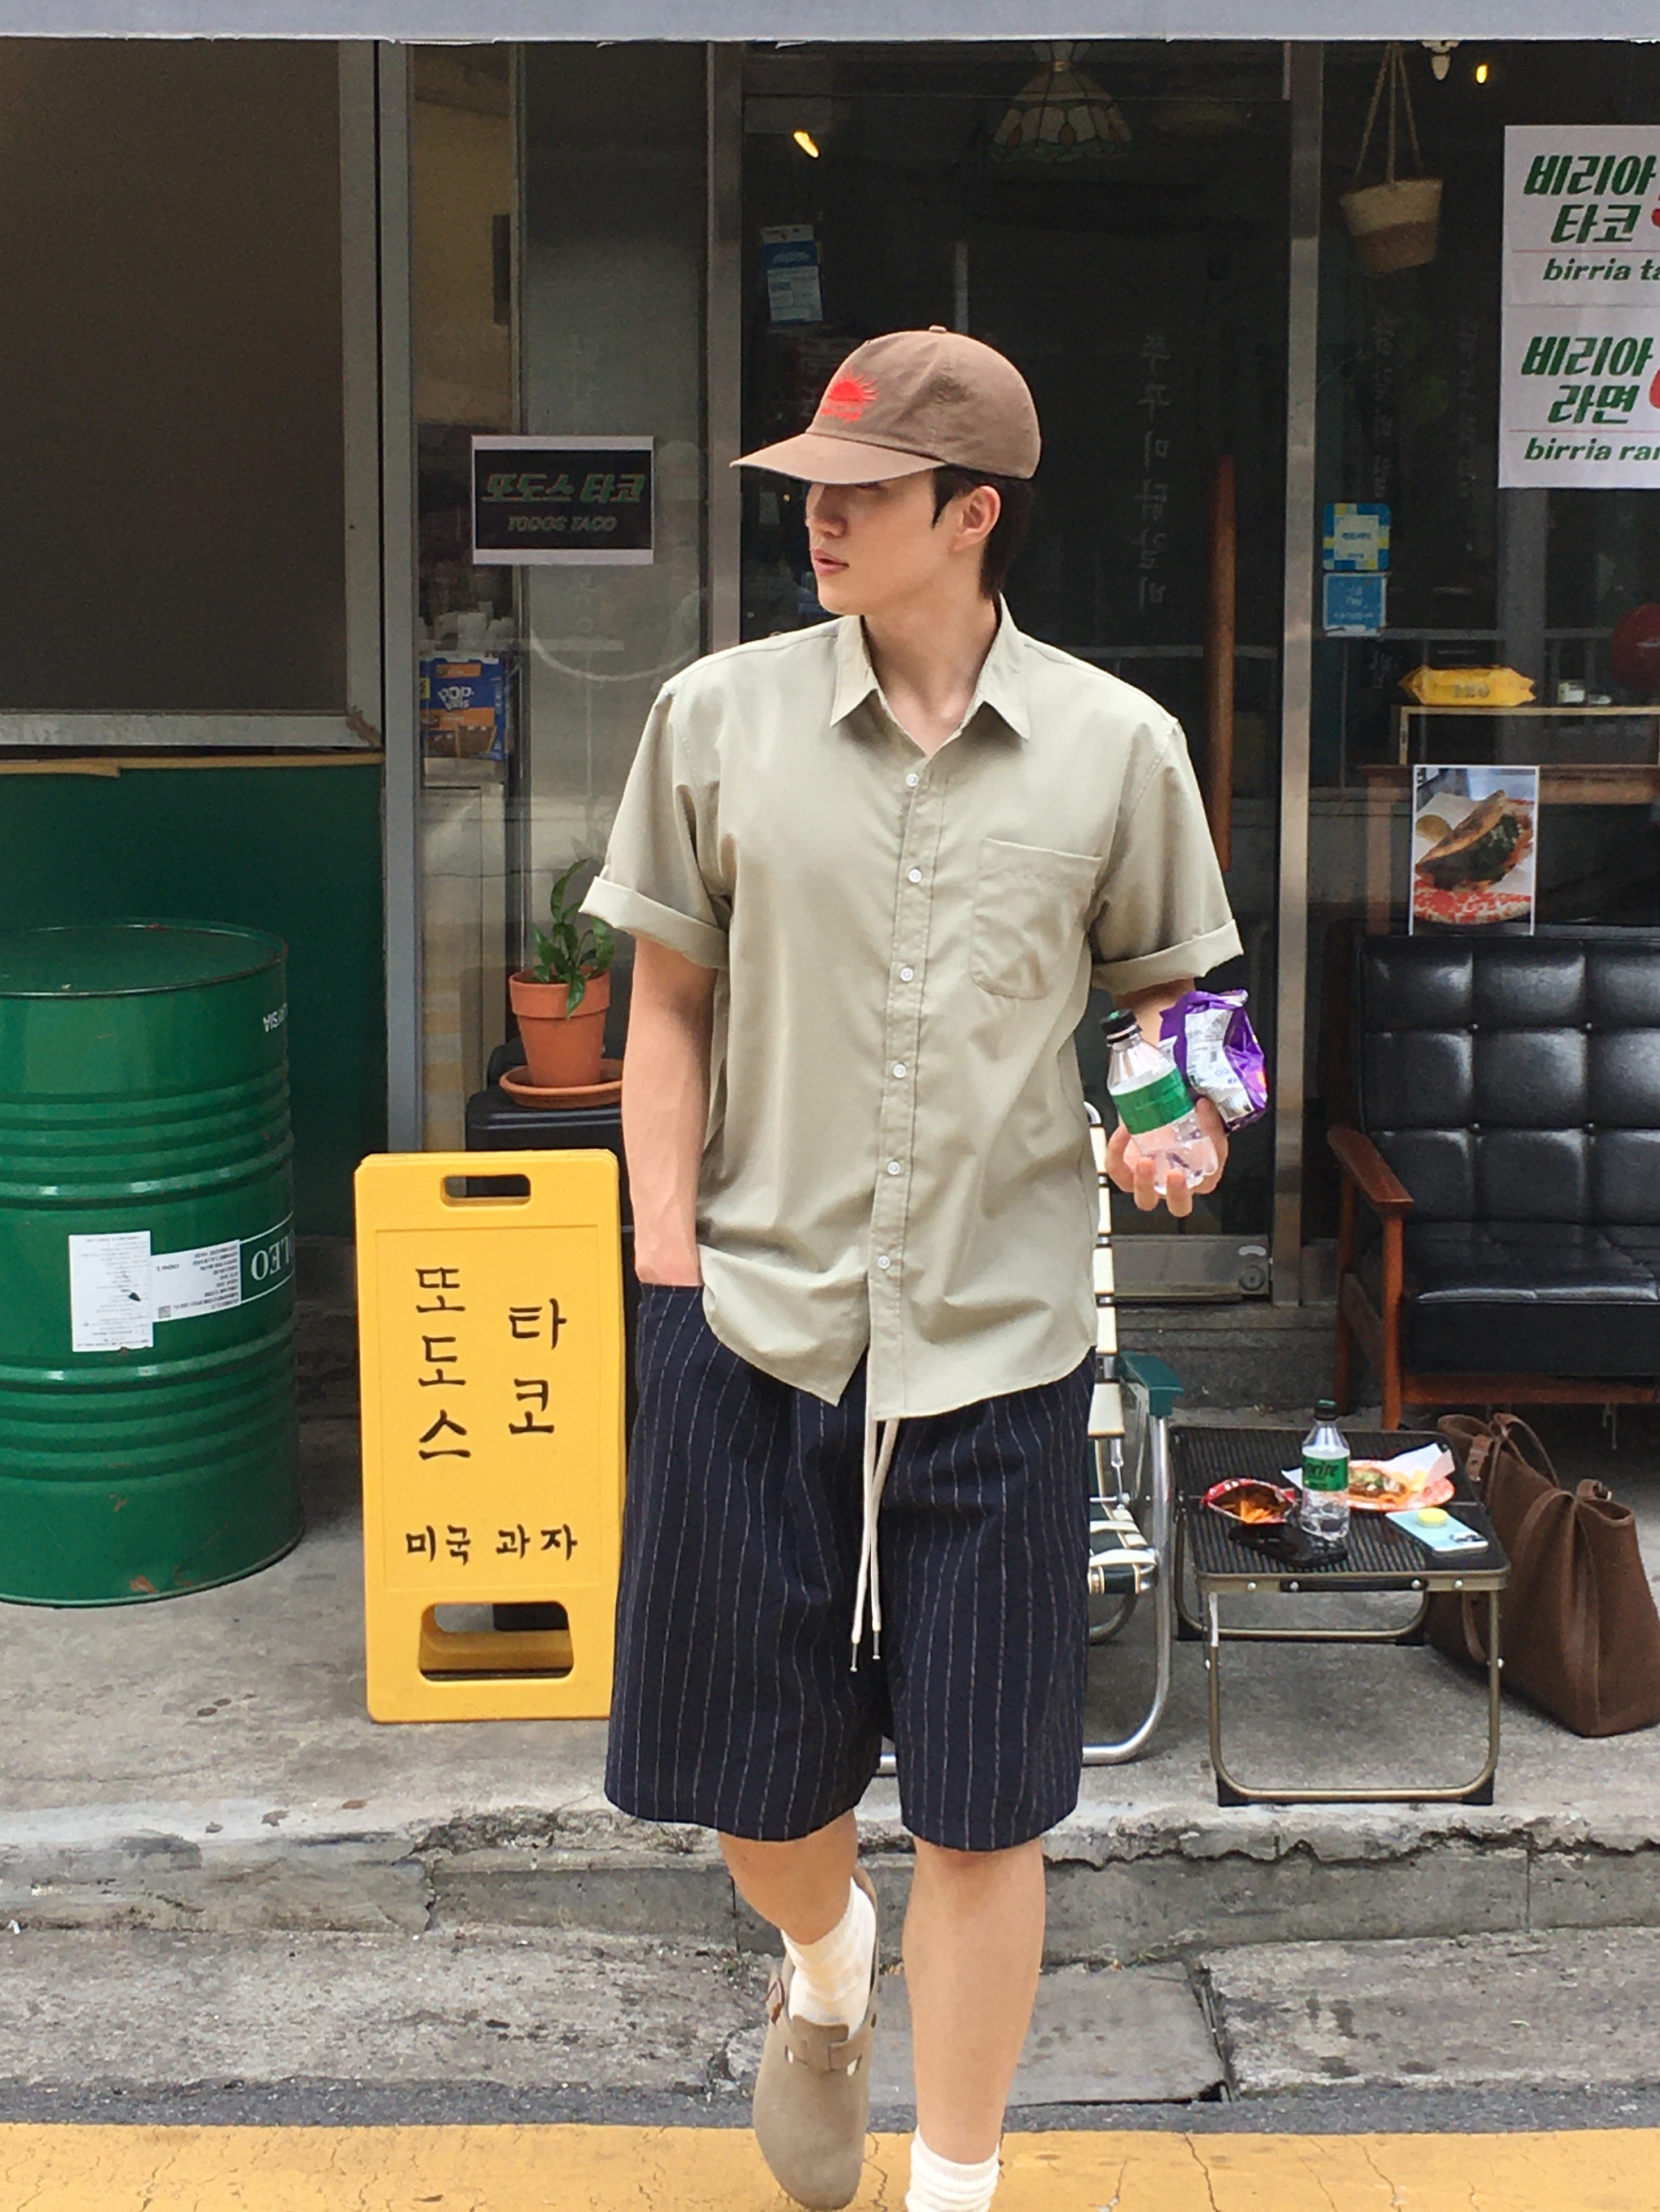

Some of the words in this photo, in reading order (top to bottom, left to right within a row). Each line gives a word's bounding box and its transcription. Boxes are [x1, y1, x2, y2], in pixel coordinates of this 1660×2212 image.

[1523, 154, 1657, 196] 비리아
[1551, 204, 1642, 244] 타코
[1543, 257, 1632, 281] birria
[1521, 336, 1654, 377] 비리아
[1548, 385, 1640, 424] 라면
[1524, 437, 1612, 460] birria
[481, 473, 575, 504] 또도스
[579, 473, 646, 504] 타코
[508, 516, 568, 532] TODOS
[570, 516, 617, 531] TACO
[415, 1267, 471, 1460] 또도스
[508, 1297, 568, 1435] 타코
[406, 1525, 471, 1566] 미국
[496, 1524, 578, 1561] 과자
